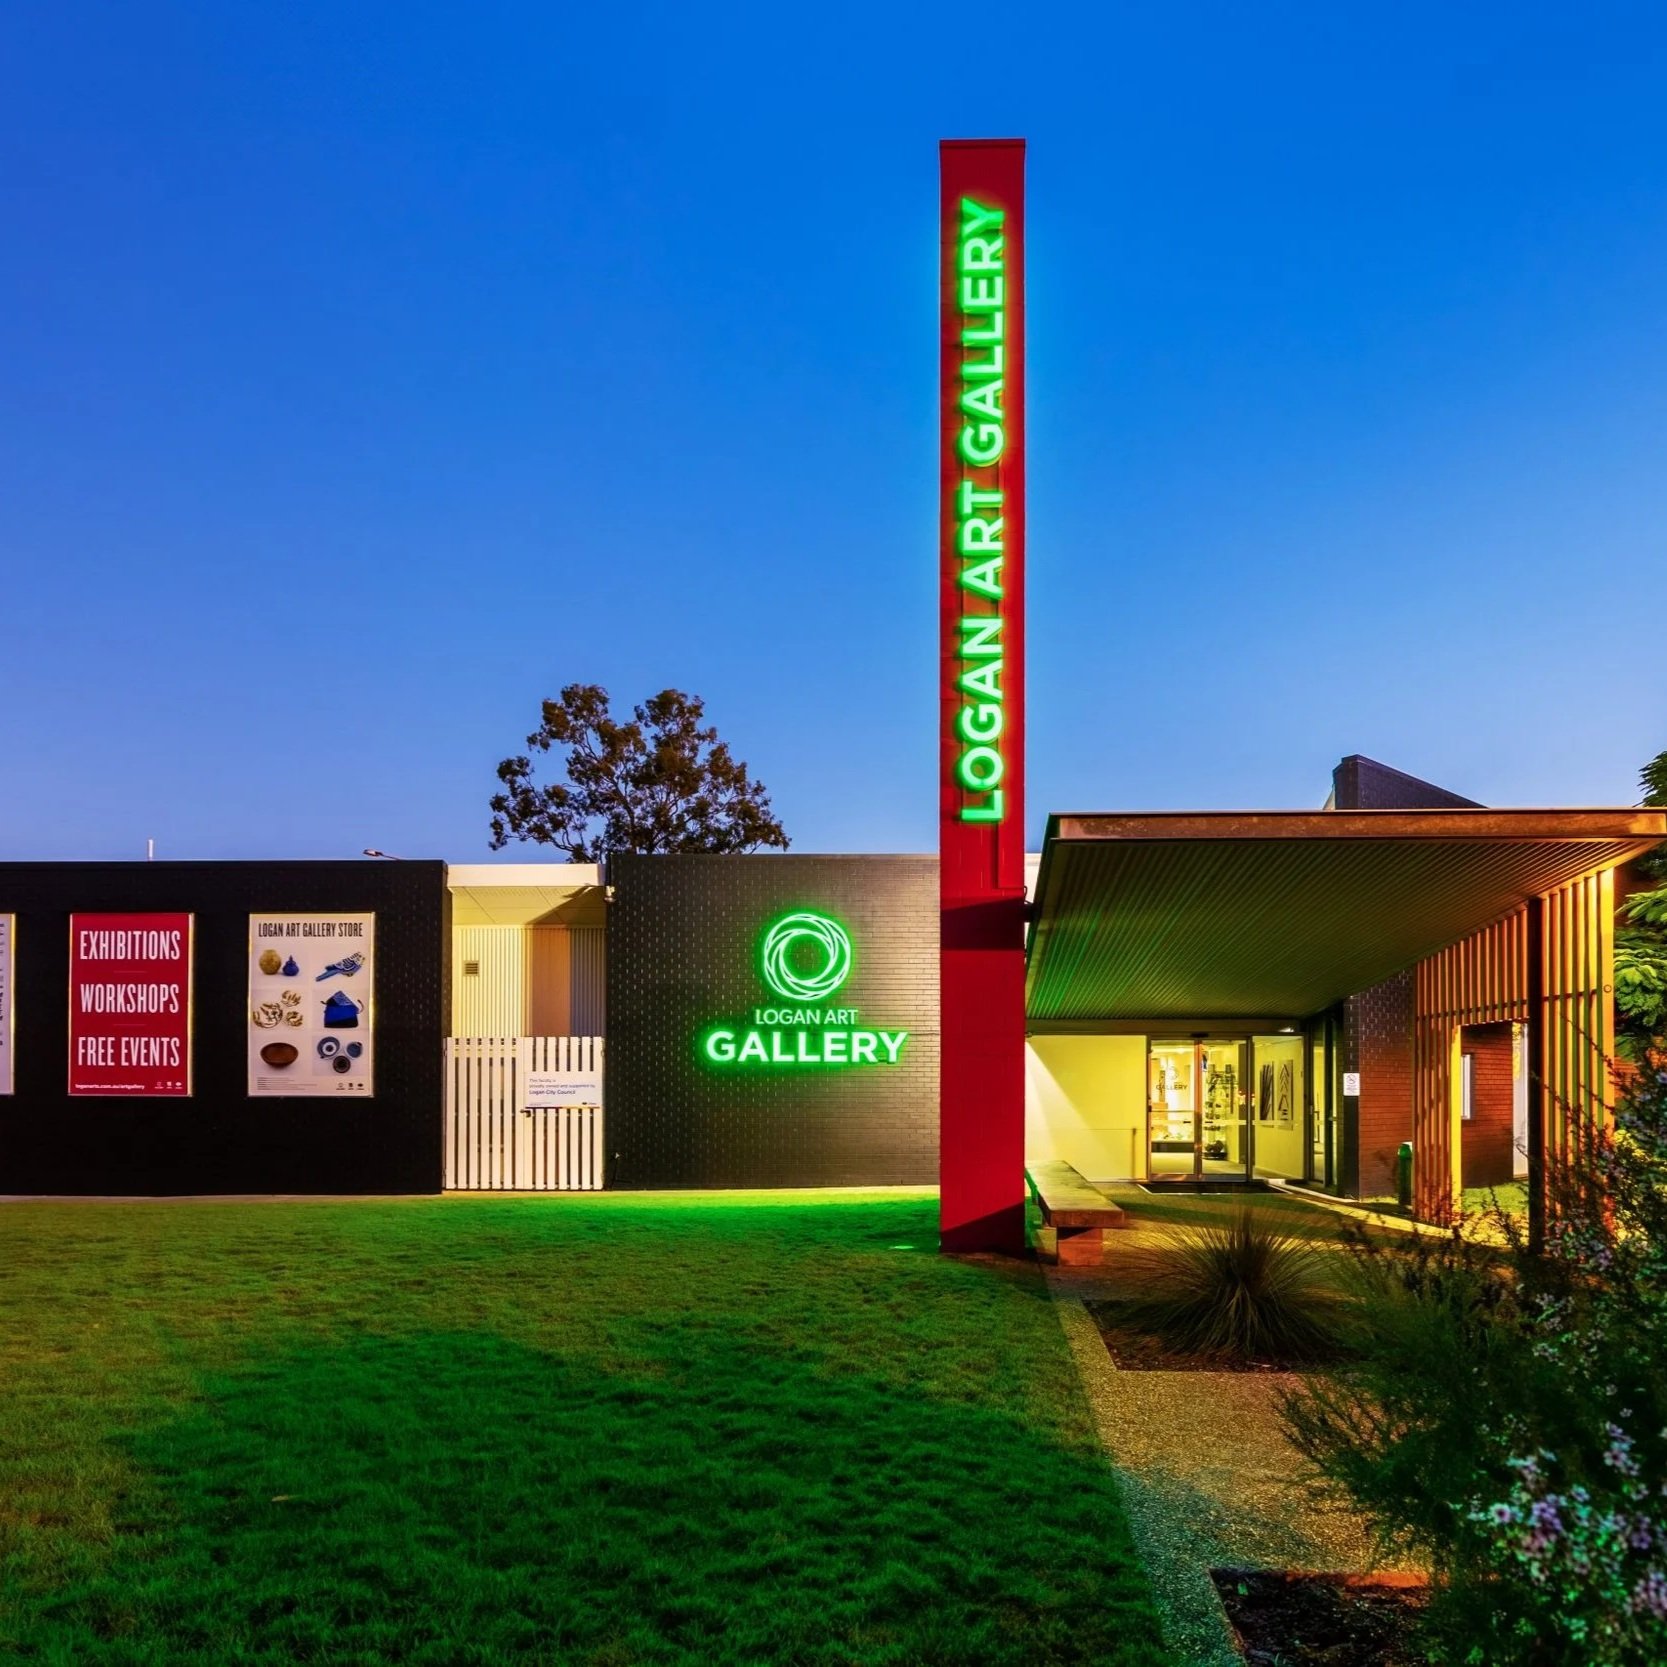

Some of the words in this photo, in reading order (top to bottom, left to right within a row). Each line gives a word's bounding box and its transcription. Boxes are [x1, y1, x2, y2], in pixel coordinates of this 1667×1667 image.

[961, 196, 1004, 468] GALLERY
[961, 481, 1004, 600] ART
[960, 617, 1004, 822] LOGAN
[79, 930, 181, 961] EXHIBITIONS
[258, 922, 284, 938] LOGAN
[285, 922, 301, 938] ART
[302, 922, 337, 938] GALLERY
[338, 922, 363, 938] STORE
[80, 983, 180, 1014] WORKSHOPS
[755, 1008, 820, 1025] LOGAN
[823, 1008, 858, 1025] ART
[77, 1036, 116, 1067] FREE
[120, 1036, 180, 1067] EVENTS
[705, 1030, 908, 1063] GALLERY
